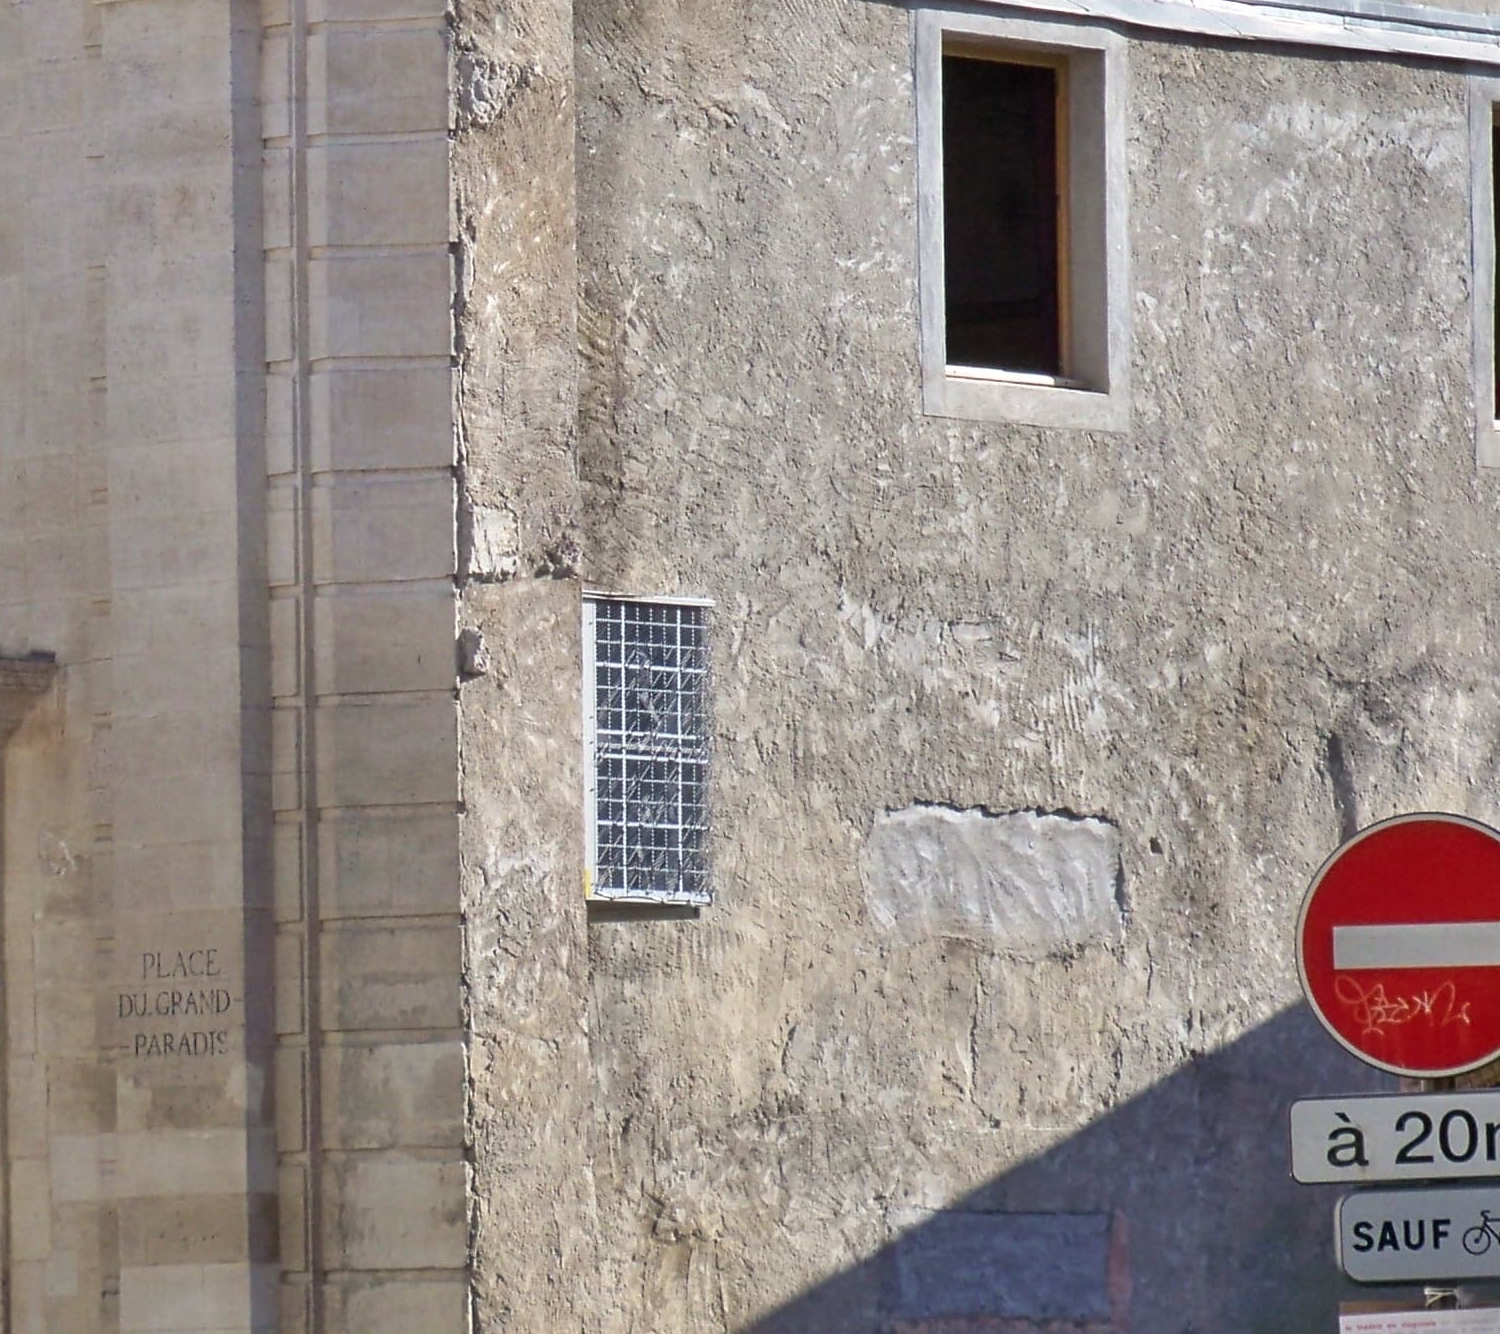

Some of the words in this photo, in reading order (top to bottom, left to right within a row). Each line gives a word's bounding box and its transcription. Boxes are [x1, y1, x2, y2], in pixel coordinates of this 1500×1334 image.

[141, 948, 221, 980] PLACE
[1326, 1112, 1369, 1167] à
[1352, 1218, 1451, 1253] SAUF
